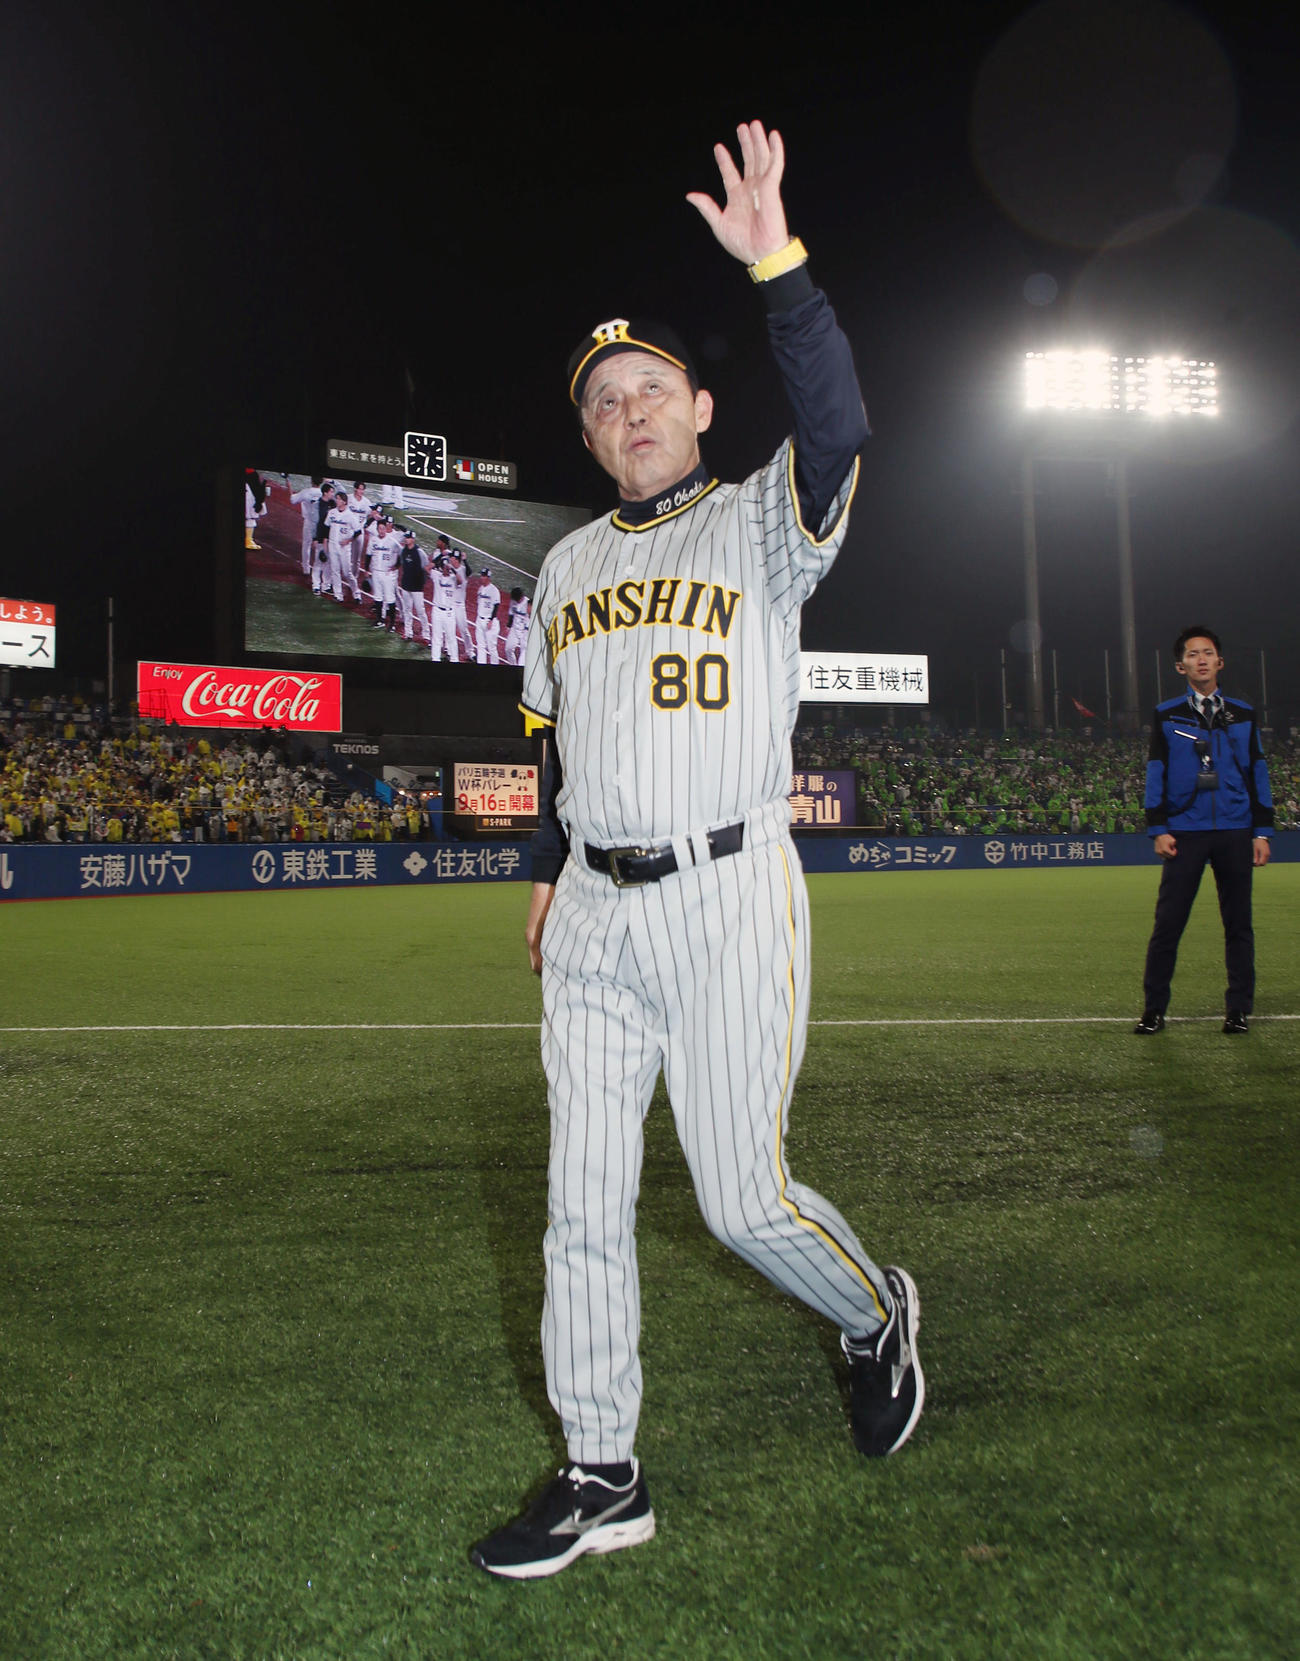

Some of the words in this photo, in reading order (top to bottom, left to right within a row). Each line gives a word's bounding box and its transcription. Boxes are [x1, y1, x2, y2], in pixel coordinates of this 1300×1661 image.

[477, 462, 509, 475] OPEN
[478, 473, 509, 485] HOUSE
[655, 498, 672, 515] 80
[152, 666, 184, 681] Enjoy
[650, 652, 731, 712] 80
[807, 664, 924, 692] 住友重機械
[181, 670, 323, 722] Coca-Cola
[332, 743, 380, 755] TEKNOS
[458, 778, 512, 792] W杯バレー
[788, 794, 841, 824] 青山
[849, 842, 957, 865] めちゃコミック
[1010, 841, 1104, 861] 竹中工務店
[80, 850, 192, 889] 安藤ハザマ
[282, 849, 378, 883] 東鉄工業
[432, 848, 520, 878] 住友化学
